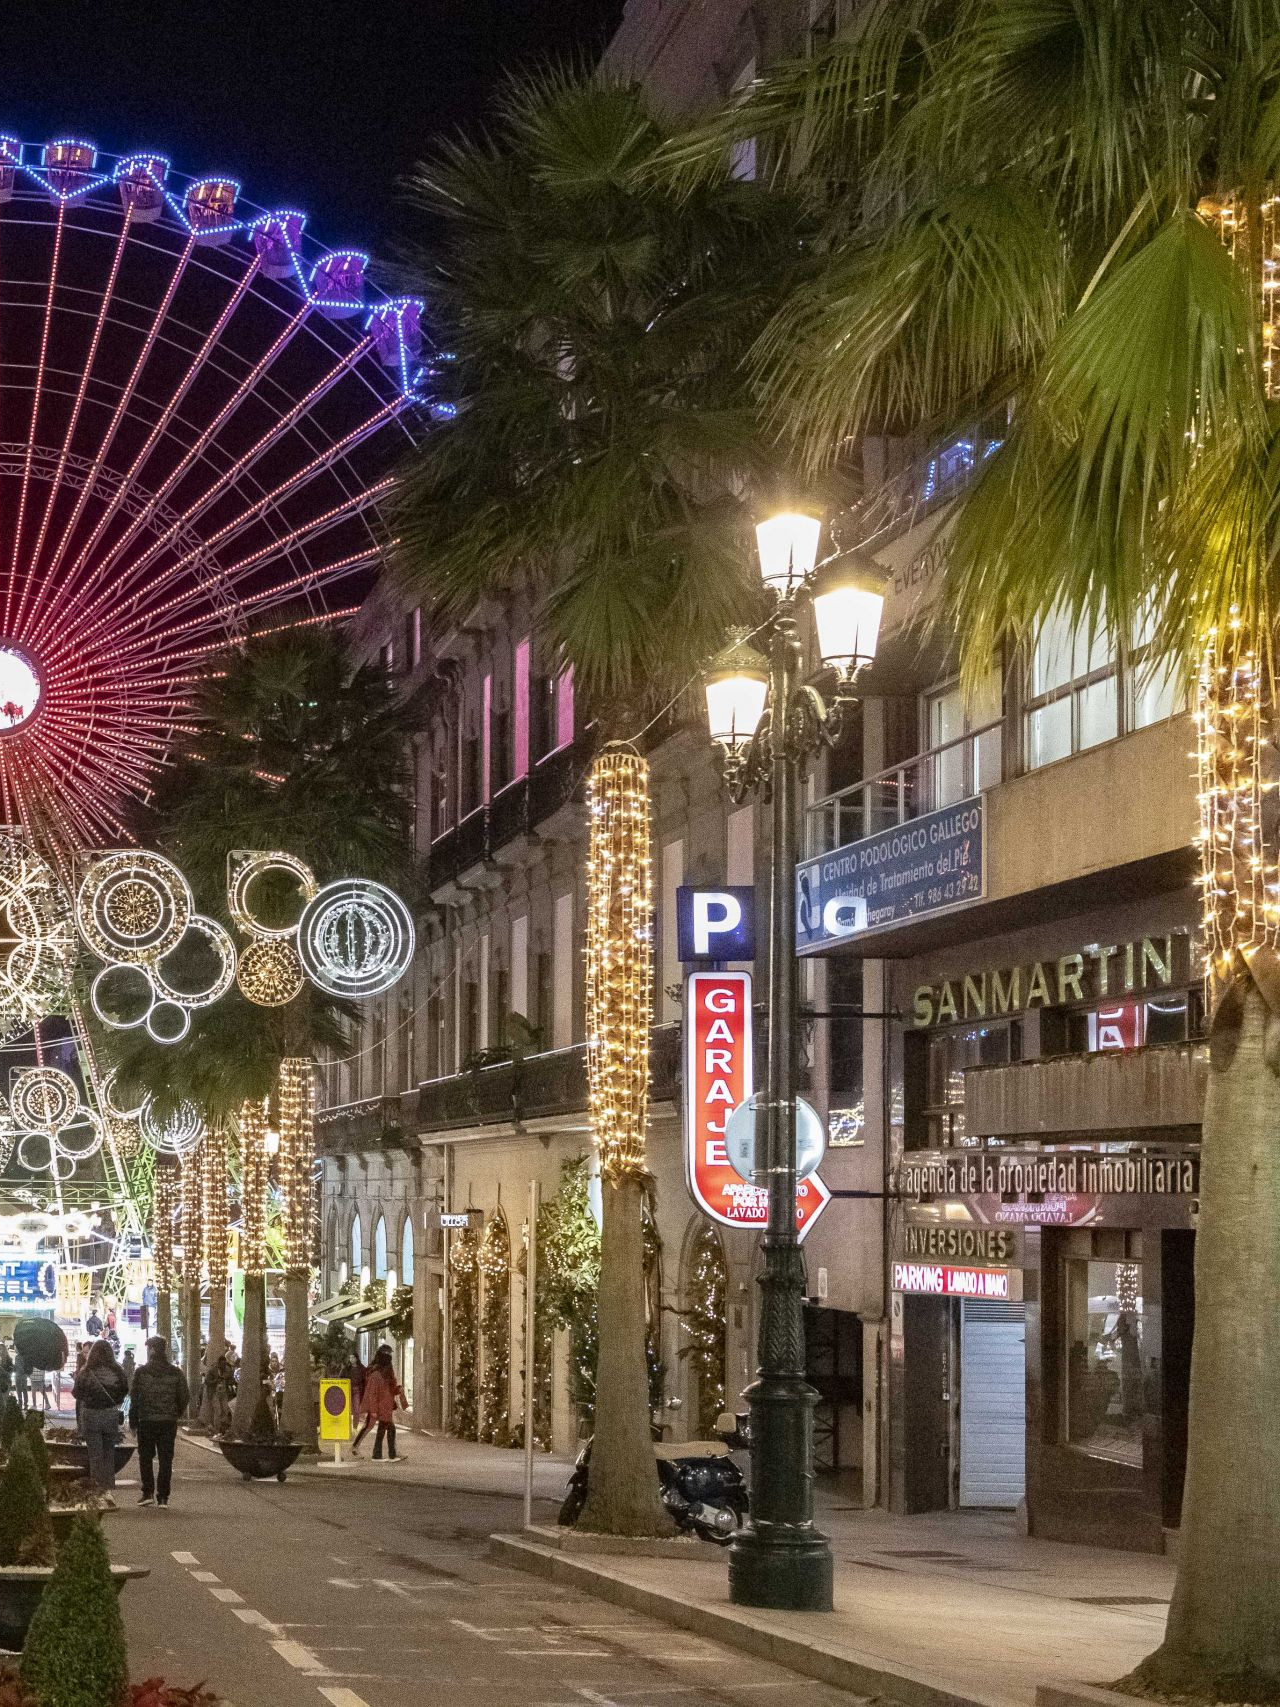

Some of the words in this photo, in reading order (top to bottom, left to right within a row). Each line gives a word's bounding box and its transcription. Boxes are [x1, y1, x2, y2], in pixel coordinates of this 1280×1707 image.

[823, 853, 857, 882] CENTRO
[860, 828, 927, 869] PODOLÓGICO
[930, 807, 979, 844] GALLEGO
[866, 876, 878, 896] de
[880, 861, 934, 891] Tratamiento
[936, 850, 951, 874] del
[943, 882, 955, 900] 43
[693, 892, 742, 954] P
[912, 934, 1171, 1027] SANMARTIN
[705, 988, 736, 1166] GARAJE
[907, 1165, 956, 1202] agencia
[961, 1155, 976, 1193] de
[982, 1155, 994, 1193] la
[998, 1156, 1077, 1203] propiedad
[1083, 1156, 1193, 1193] inmobiliaria
[726, 1206, 766, 1218] LAVADO
[905, 1228, 1007, 1259] INVERSIONES
[894, 1265, 944, 1293] PARKING
[947, 1271, 977, 1294] LAVADO
[977, 1273, 985, 1295] A
[985, 1273, 1008, 1297] MANO
